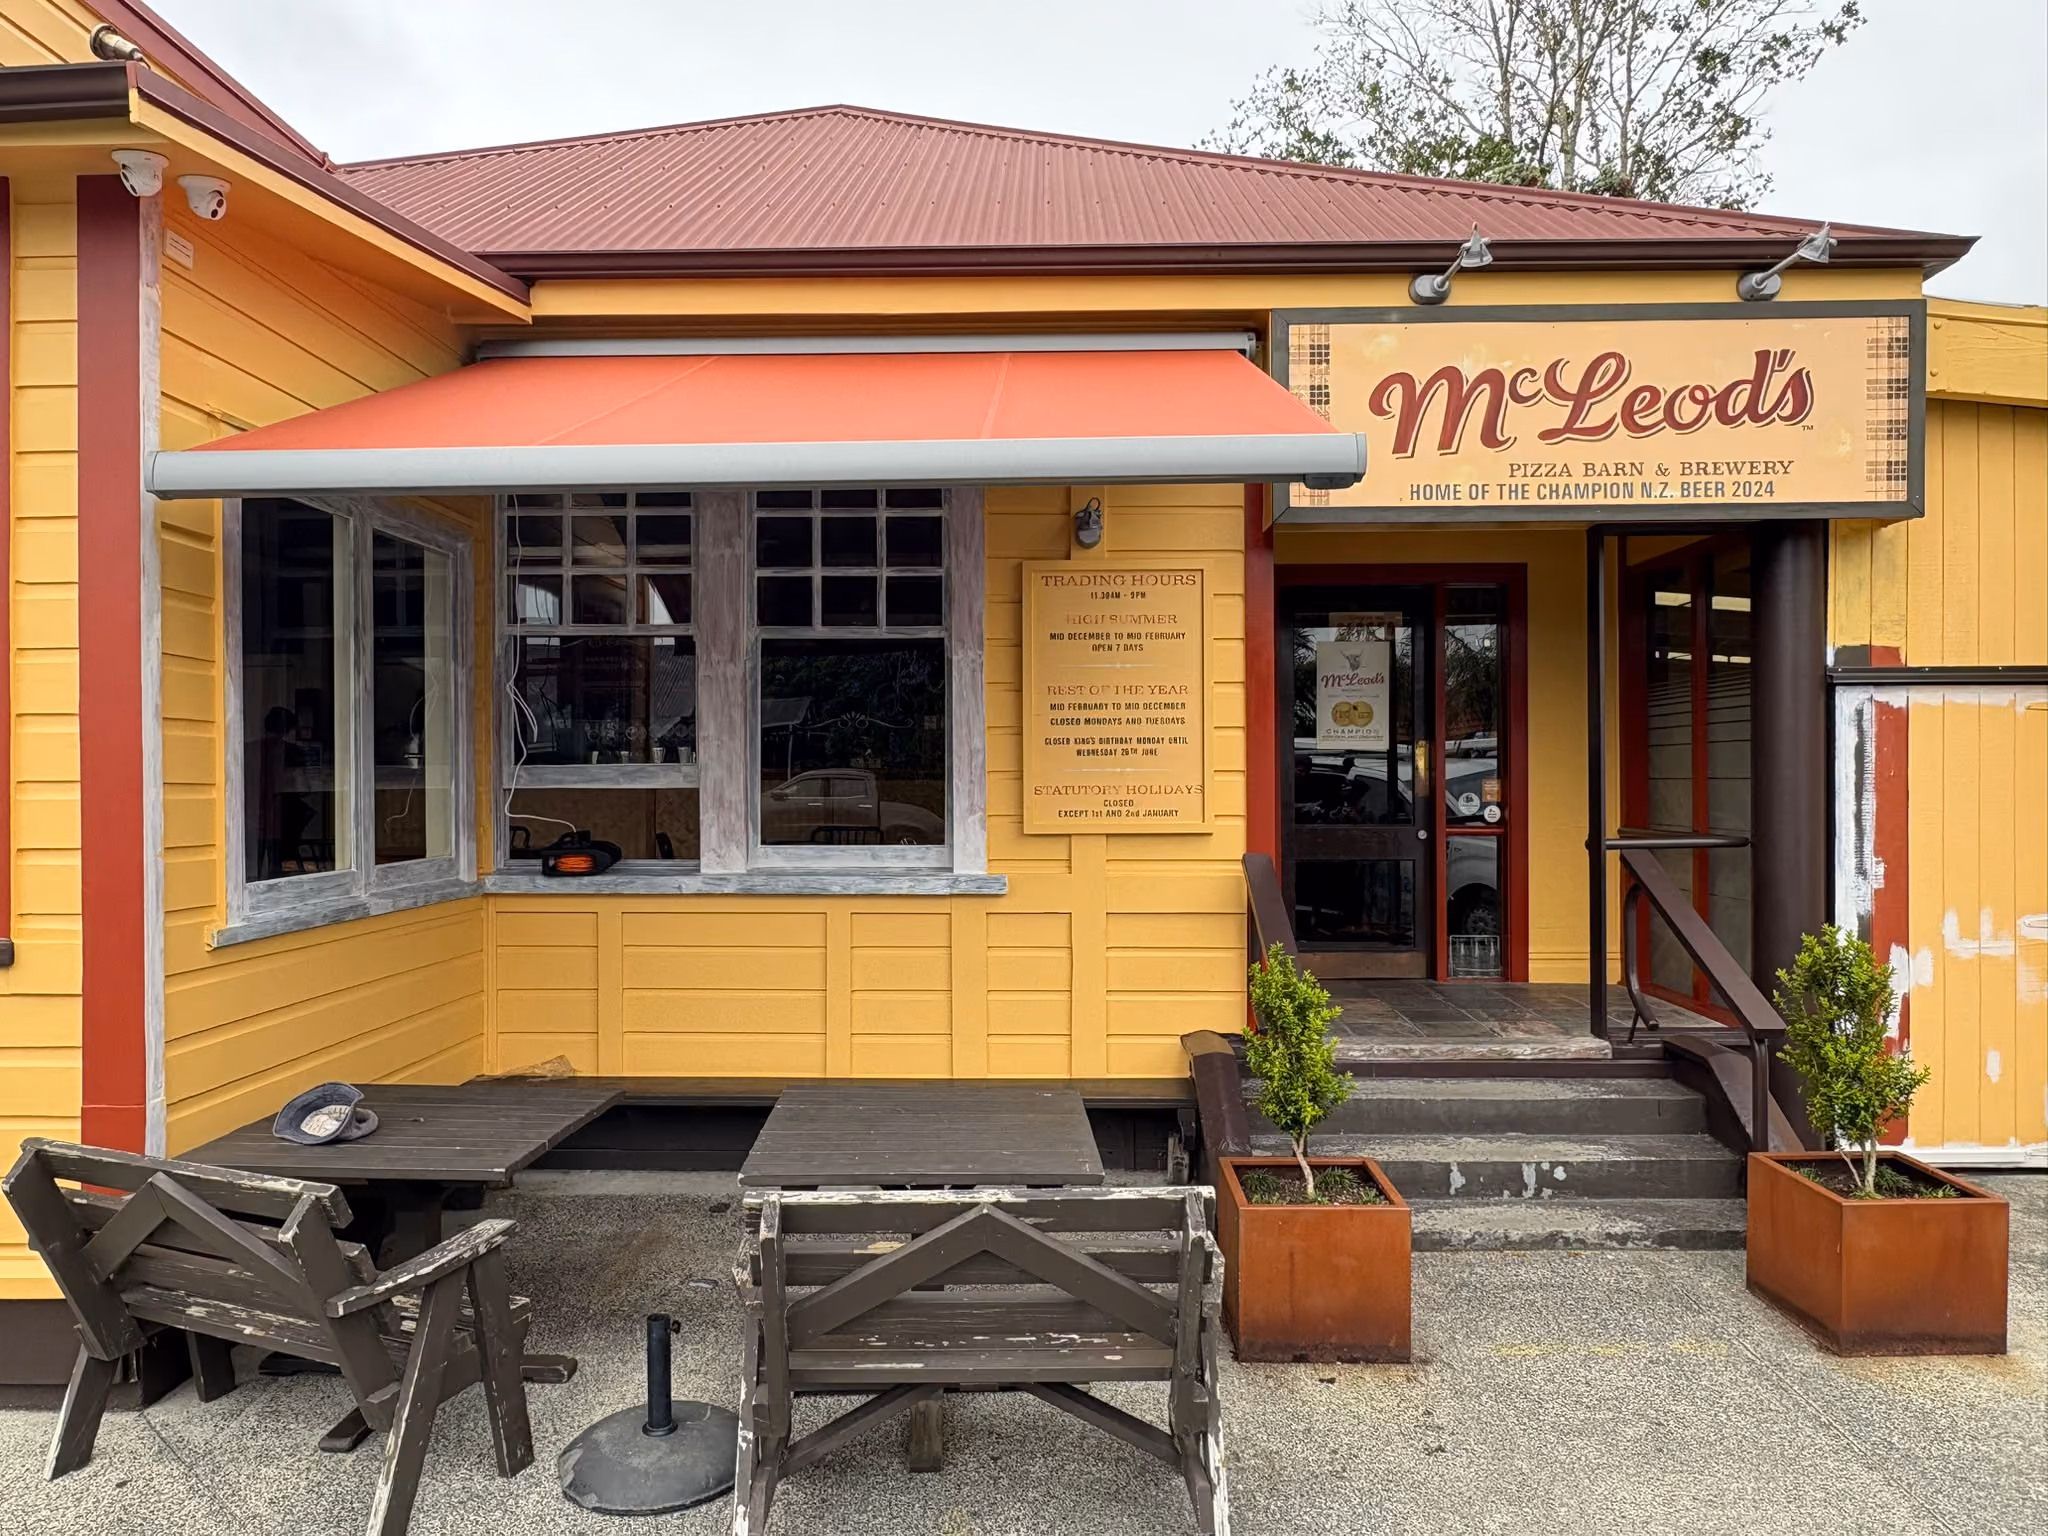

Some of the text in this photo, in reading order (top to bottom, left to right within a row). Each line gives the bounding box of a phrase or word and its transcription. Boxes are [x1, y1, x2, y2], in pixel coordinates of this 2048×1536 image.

[1368, 348, 1814, 458] McLeod's
[1509, 460, 1795, 478] PIZZA BARN & BREWERY
[1410, 480, 1775, 501] HOME OF THE CHAMPION N.Z. BEER 2024
[1042, 575, 1196, 586] TRADING HOURS
[1110, 614, 1178, 624] SUMMER
[1127, 632, 1141, 640] MID
[1145, 632, 1186, 640] FEBRUARY
[1321, 672, 1384, 688] McLeod's
[1047, 685, 1087, 695] REST
[1148, 685, 1188, 695] YEAR
[1126, 717, 1141, 725] AND
[1146, 717, 1185, 725] TUESDAYS
[1045, 737, 1070, 745] CLOSED
[1034, 785, 1204, 795] STATUTORY HOLIDAYS
[1104, 799, 1133, 807] CLOSED
[1143, 809, 1178, 817] JANUARY
